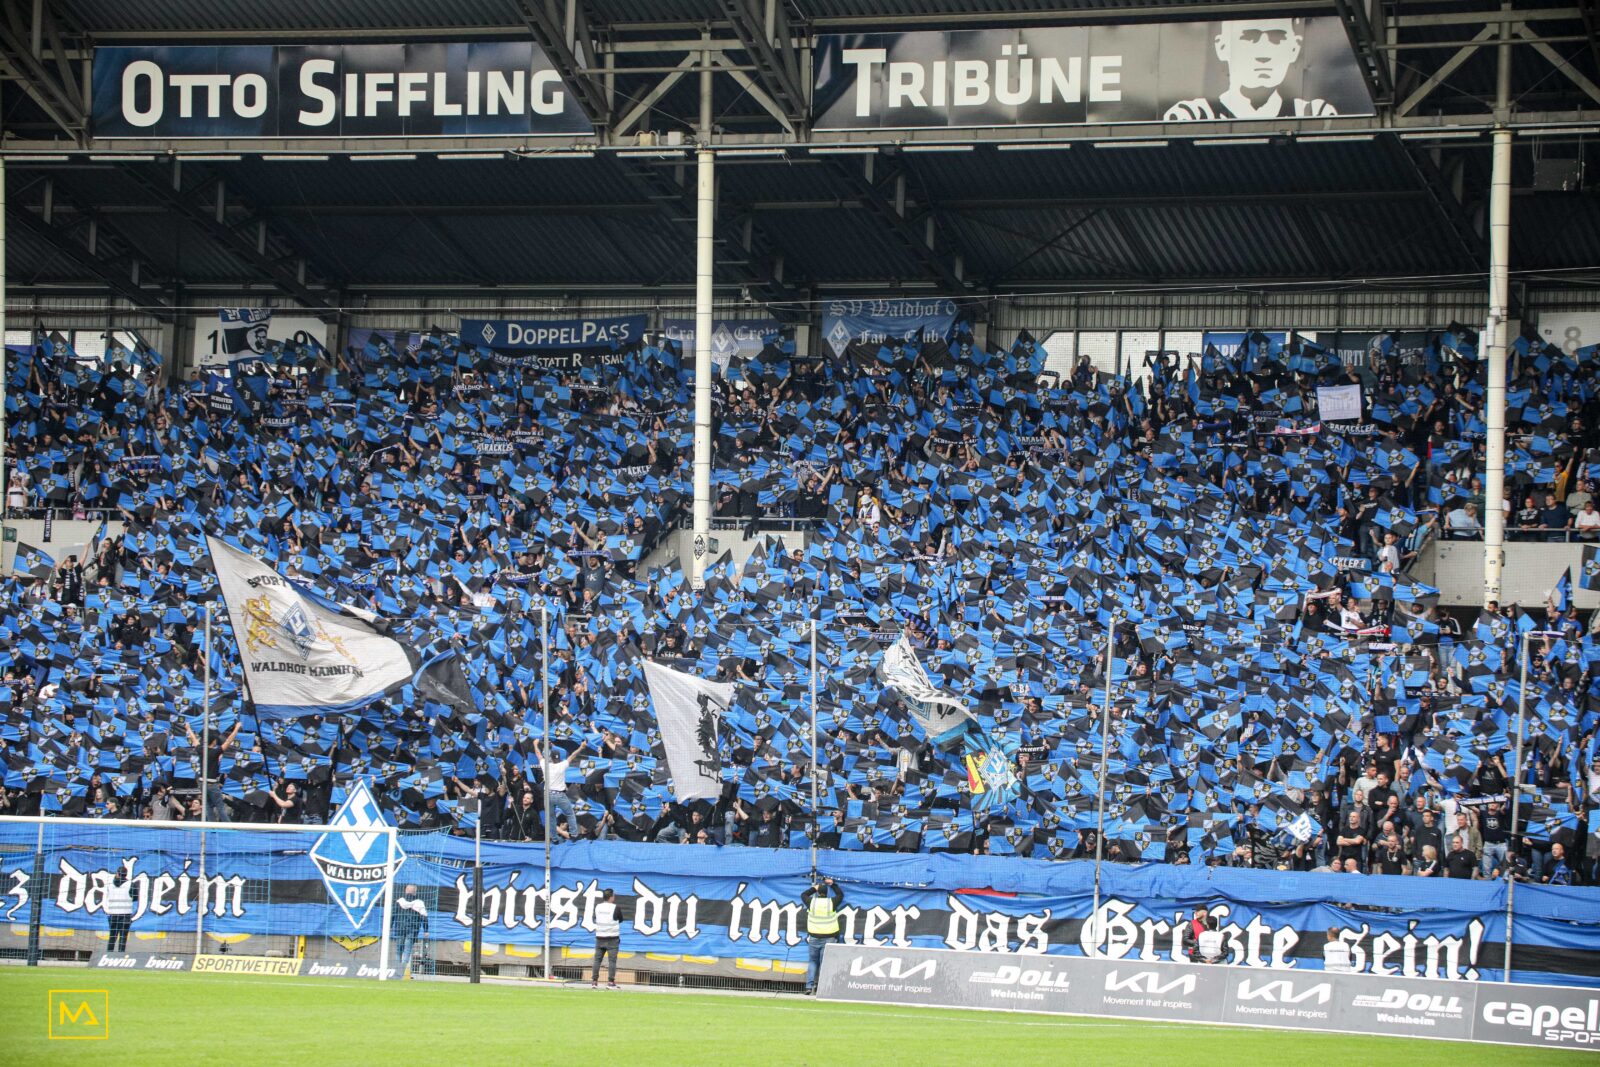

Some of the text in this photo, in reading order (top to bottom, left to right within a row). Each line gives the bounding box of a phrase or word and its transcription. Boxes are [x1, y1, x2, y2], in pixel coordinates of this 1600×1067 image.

[842, 44, 1122, 117] TRIBÜNE
[121, 58, 565, 127] OTTO SIFFLING
[345, 886, 371, 908] 07
[98, 954, 184, 970] bwin bwin
[195, 957, 298, 974] SPORTWETTEN
[308, 962, 348, 976] bwin
[849, 955, 937, 980] KIA
[848, 981, 933, 994] Movement that inspires
[1105, 969, 1196, 995] KIA
[991, 988, 1044, 1000] Weinheim
[1237, 978, 1332, 1005] KIA
[1103, 995, 1193, 1010] Movement that inspires
[1236, 1005, 1328, 1019] Movement that inspires
[1376, 1012, 1436, 1026] Weinheim
[1483, 999, 1600, 1037] capel
